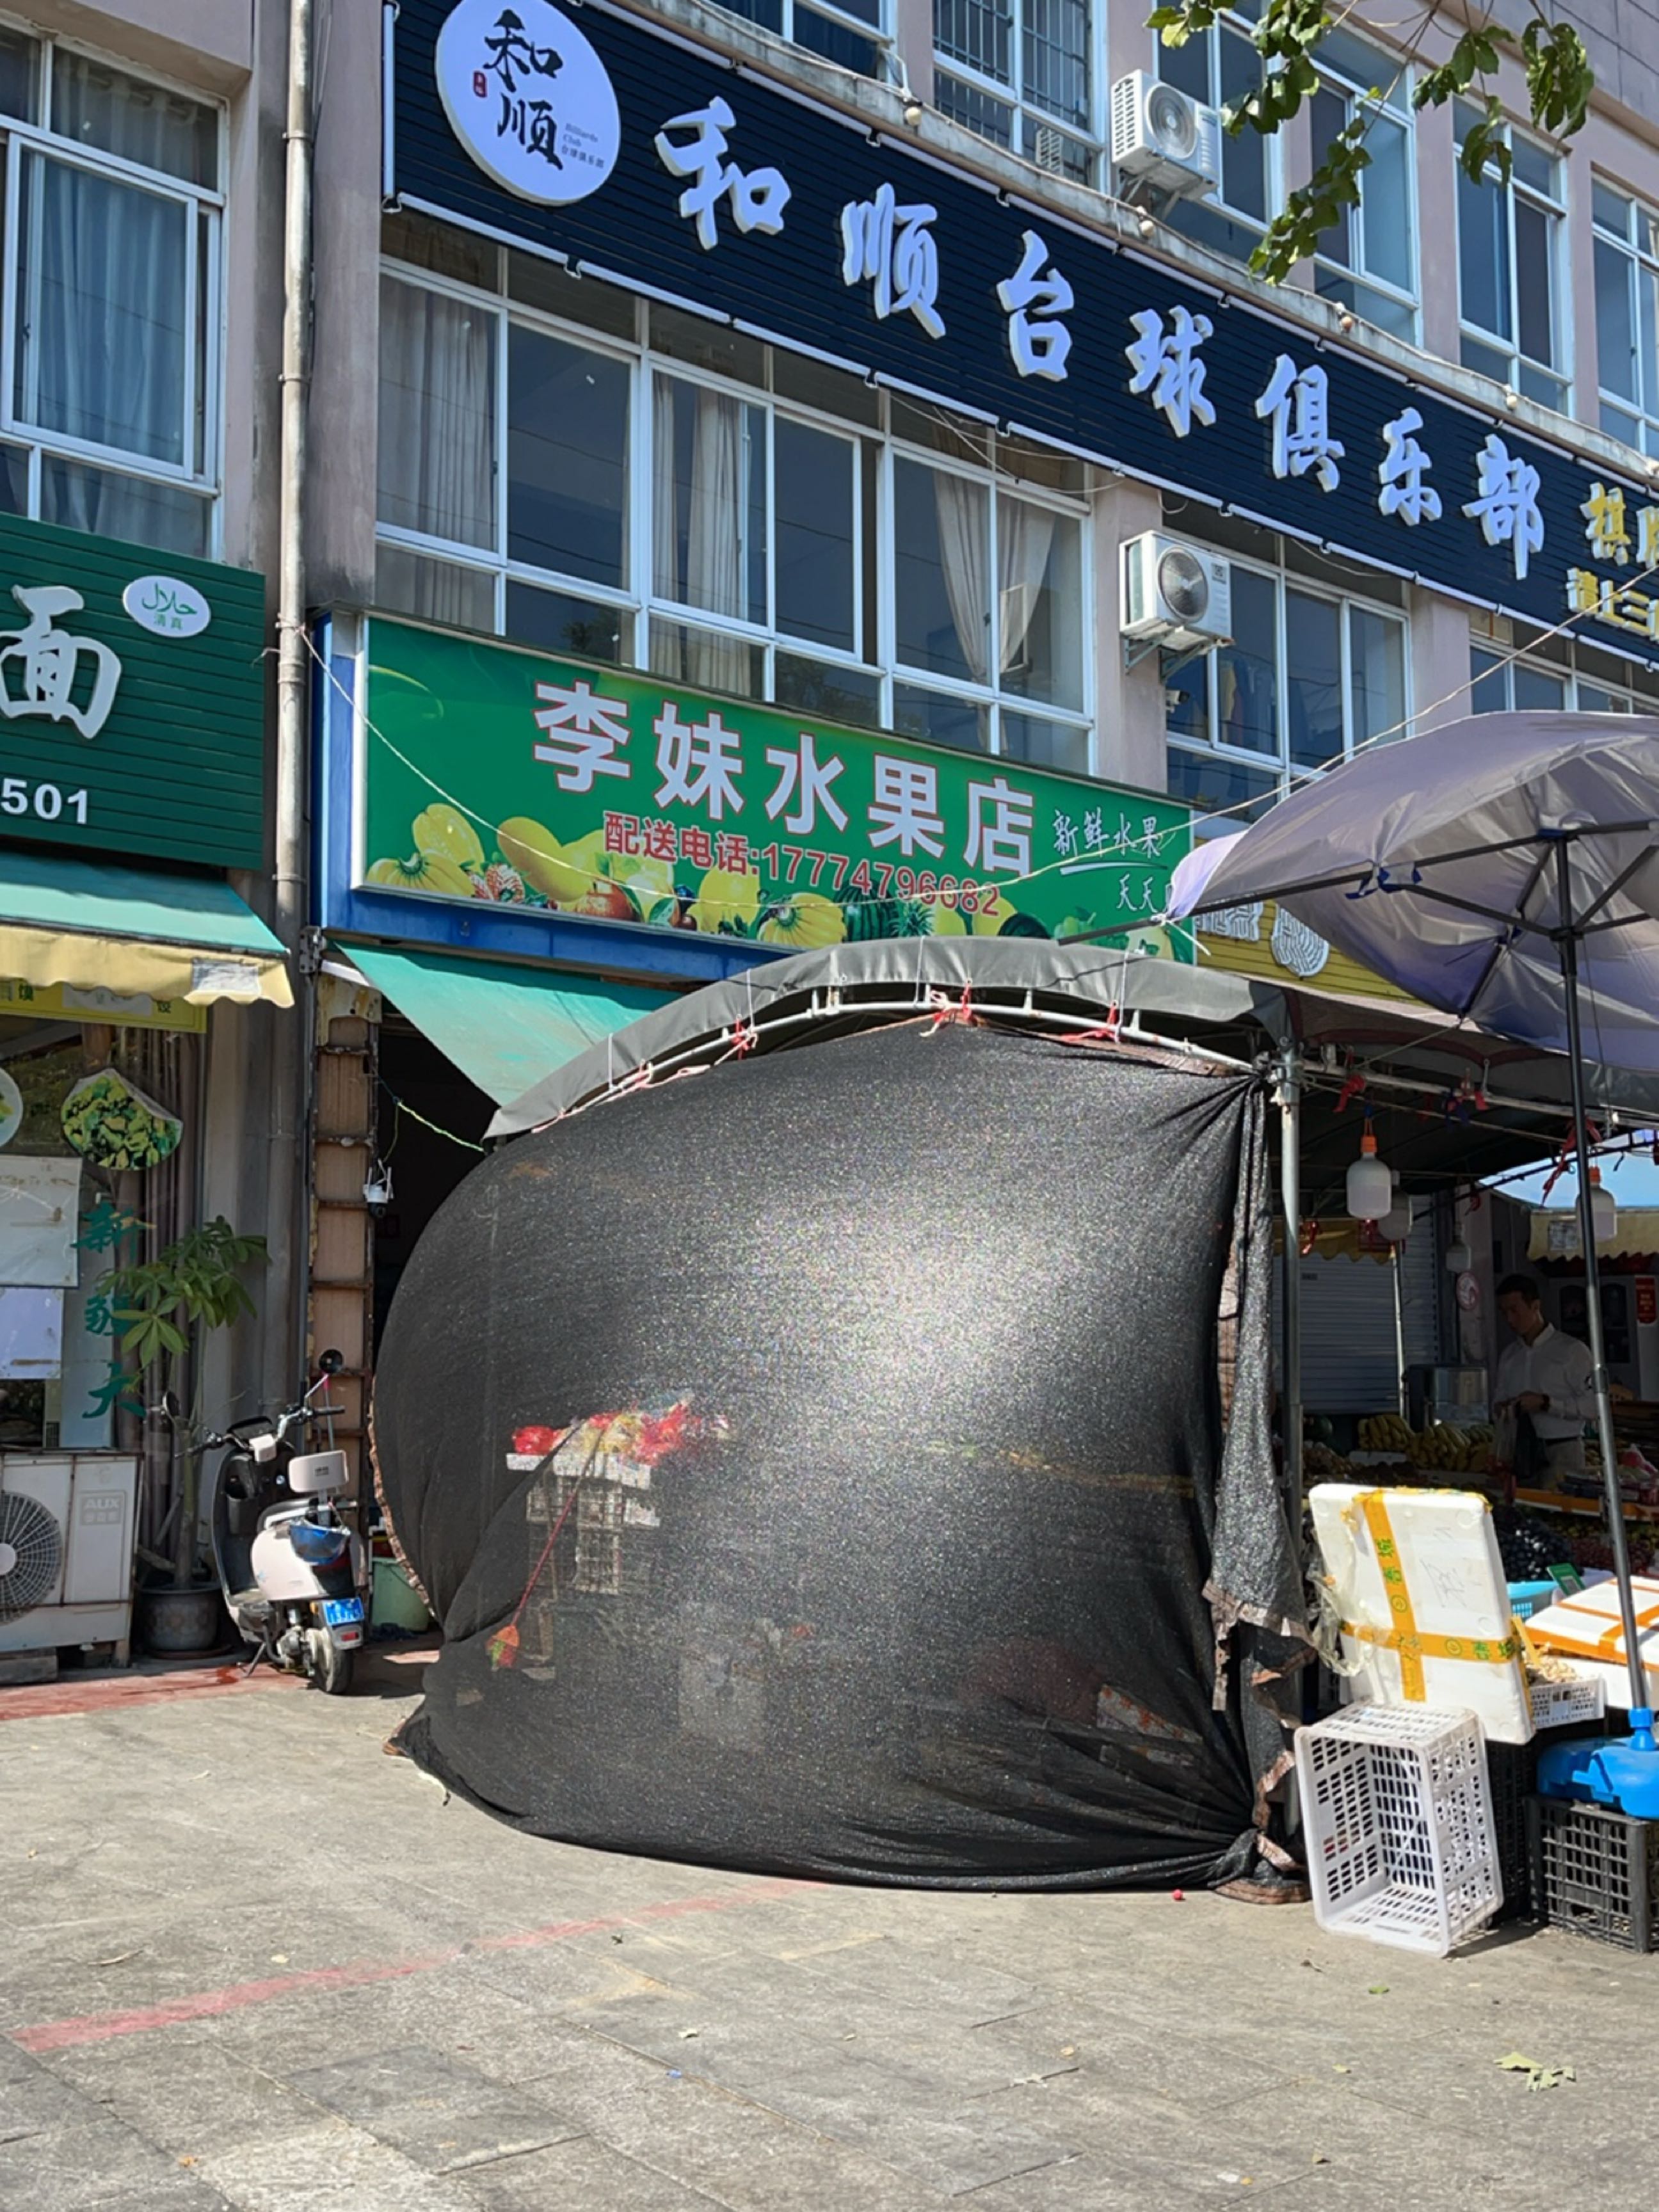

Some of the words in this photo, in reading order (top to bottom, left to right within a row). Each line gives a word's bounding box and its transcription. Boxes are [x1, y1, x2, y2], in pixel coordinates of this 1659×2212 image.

[483, 10, 564, 170] 和顺
[655, 96, 1544, 581] 和顺台球俱乐部
[0, 584, 122, 739] 面
[154, 613, 184, 631] 清真
[532, 679, 1036, 878] 李妹水果店
[1052, 806, 1161, 859] 新鲜水果
[1116, 873, 1174, 914] 天天
